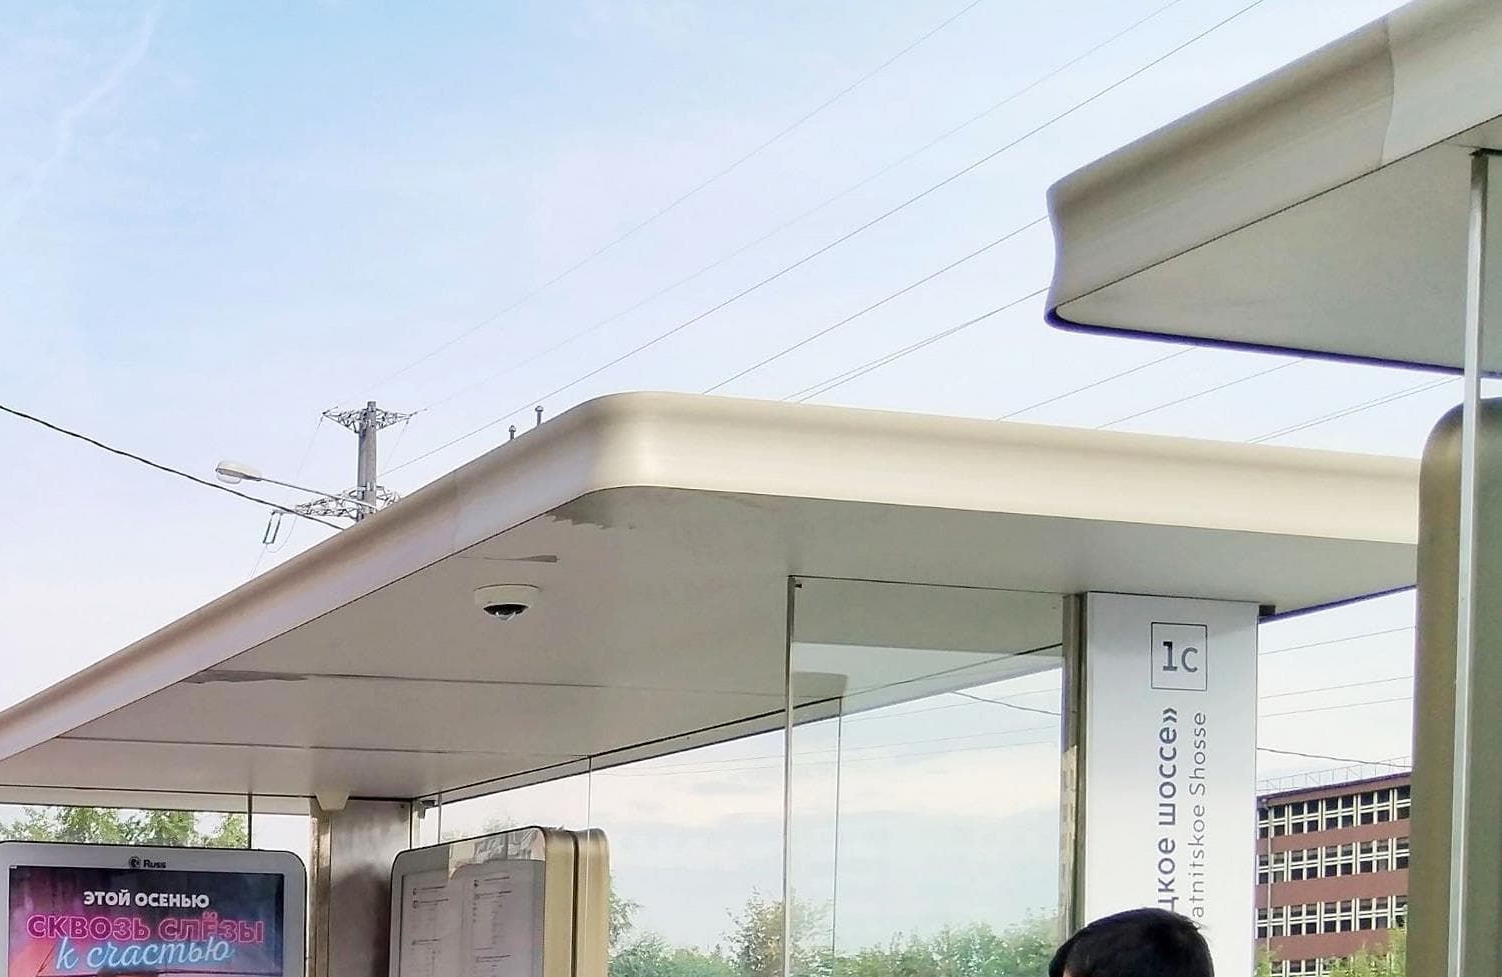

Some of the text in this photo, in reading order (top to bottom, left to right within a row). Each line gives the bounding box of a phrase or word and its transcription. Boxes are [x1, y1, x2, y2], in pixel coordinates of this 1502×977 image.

[1157, 707, 1179, 911] цкое шоссе»
[1188, 712, 1206, 920] atnitskoe Shosse
[143, 859, 166, 868] Russ
[83, 889, 210, 909] ЭТОЙ ОСЕНЬЮ
[26, 911, 264, 943] СКВОЗЬ СЛЁЗЫ
[86, 935, 235, 969] счастью
